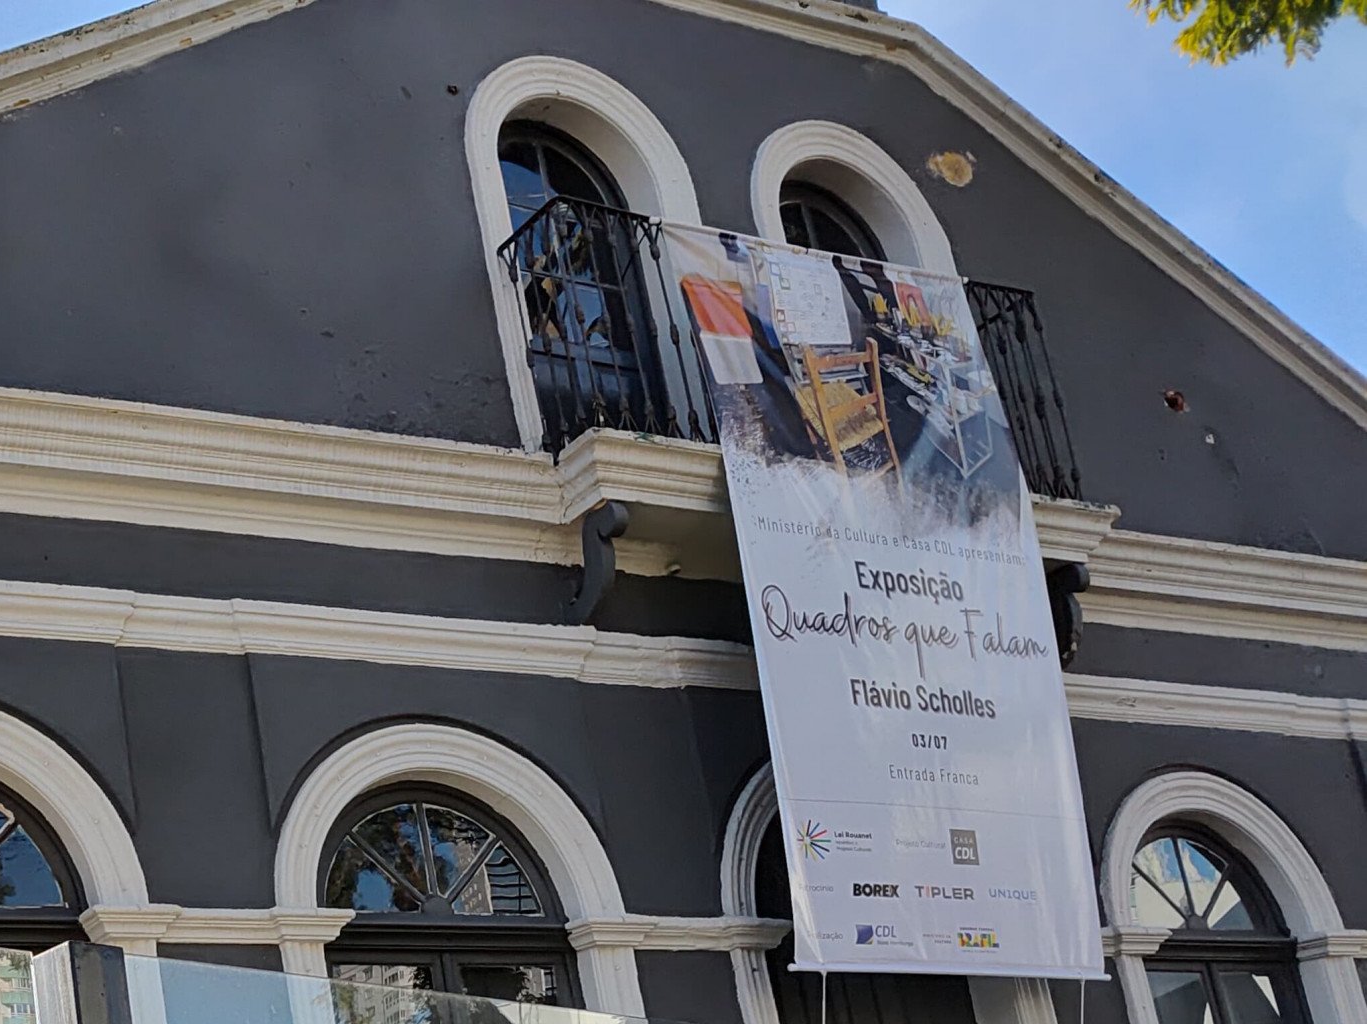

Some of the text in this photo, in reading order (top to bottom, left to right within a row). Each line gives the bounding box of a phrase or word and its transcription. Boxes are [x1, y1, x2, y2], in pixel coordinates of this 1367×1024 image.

[758, 517, 822, 537] Ministério
[826, 525, 840, 540] da
[844, 528, 889, 546] Cultura
[892, 538, 900, 548] e
[902, 536, 931, 551] Casa
[934, 540, 955, 556] CDL
[854, 560, 964, 604] Exposição
[761, 584, 1049, 679] Quadros que Falam
[849, 677, 997, 719] Flávio Scholles
[911, 733, 947, 750] 03/07
[889, 764, 979, 786] Entrada Franca
[954, 846, 976, 860] CDL
[852, 882, 899, 898] BOREX
[914, 885, 974, 901] TIPLER
[875, 923, 897, 938] CDL
